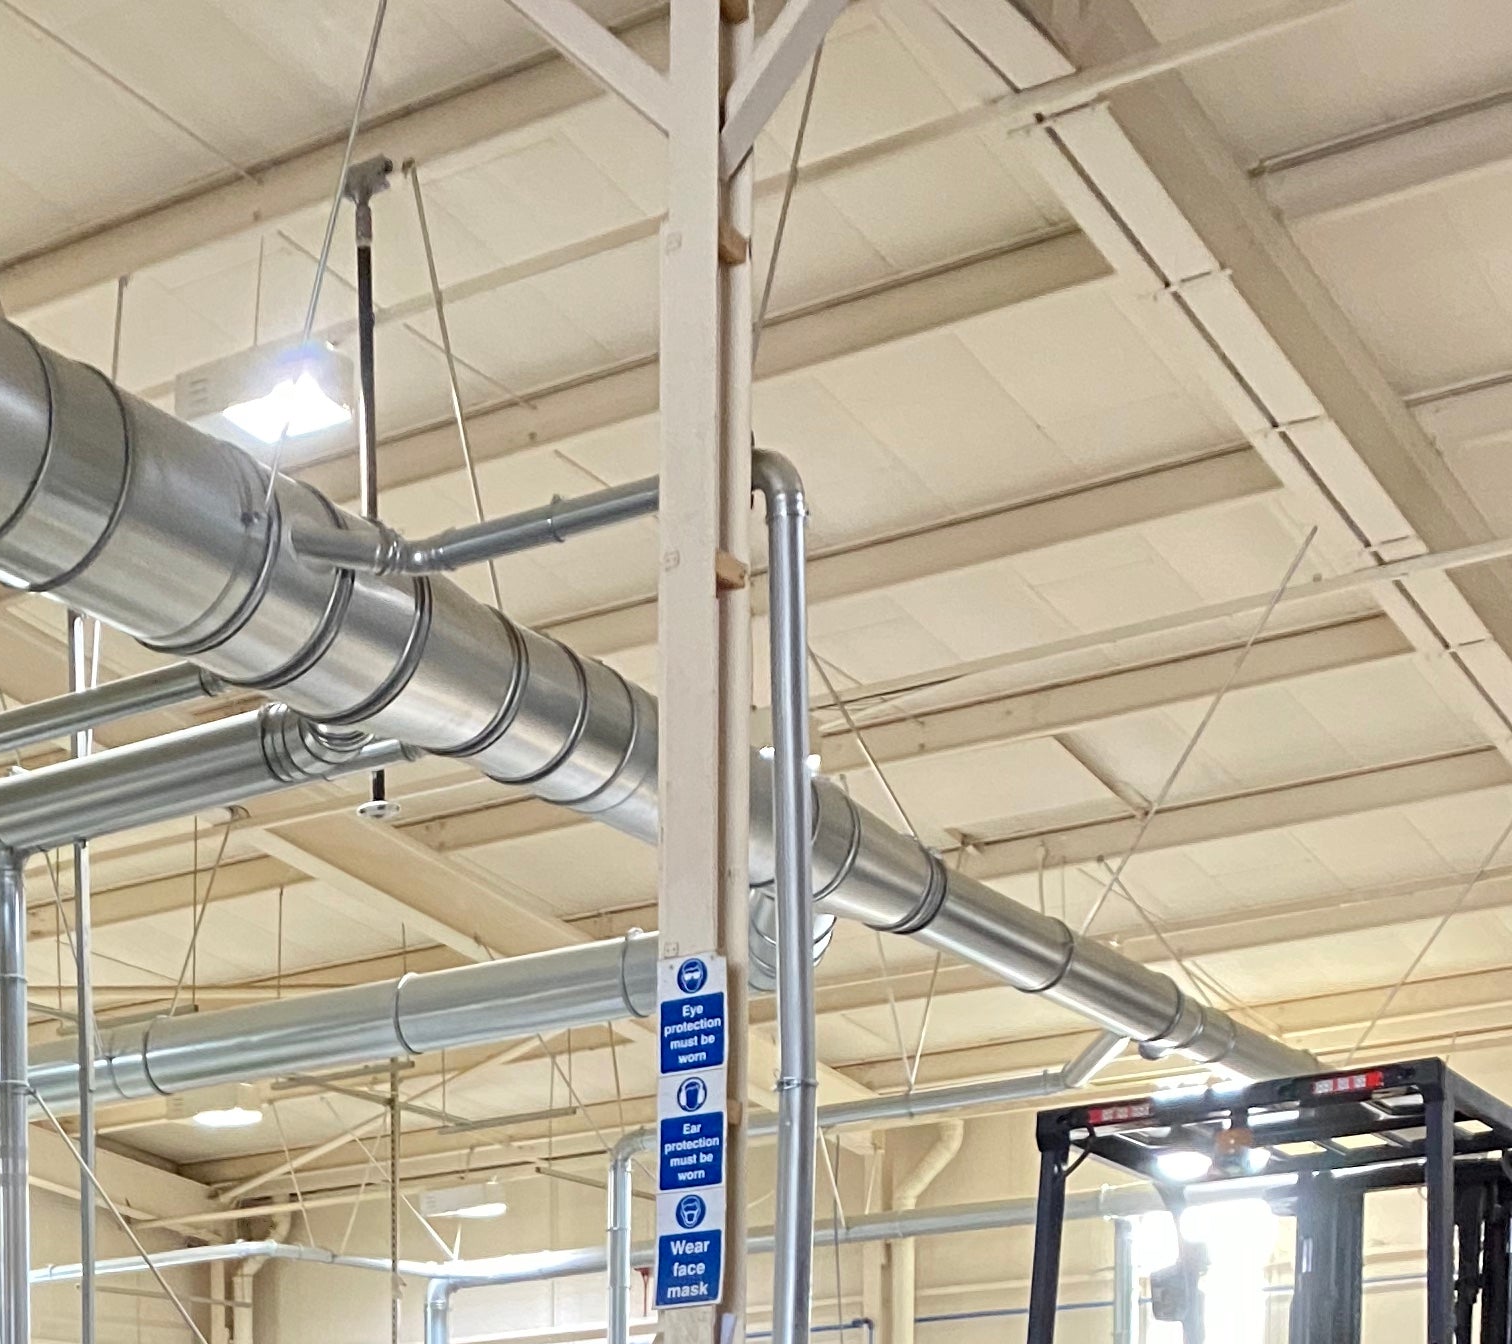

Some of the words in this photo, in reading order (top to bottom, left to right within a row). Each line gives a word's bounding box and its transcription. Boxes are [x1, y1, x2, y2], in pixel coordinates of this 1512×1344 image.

[682, 1004, 704, 1018] Eye
[664, 1017, 722, 1038] protection
[670, 1035, 698, 1050] must
[700, 1034, 716, 1046] be
[678, 1051, 707, 1064] worn
[682, 1123, 702, 1135] Ear
[664, 1136, 720, 1155] protection
[669, 1153, 697, 1167] must
[699, 1152, 714, 1163] be
[677, 1169, 705, 1181] worn
[670, 1240, 711, 1256] Wear
[673, 1262, 706, 1277] face
[667, 1281, 709, 1298] mask
